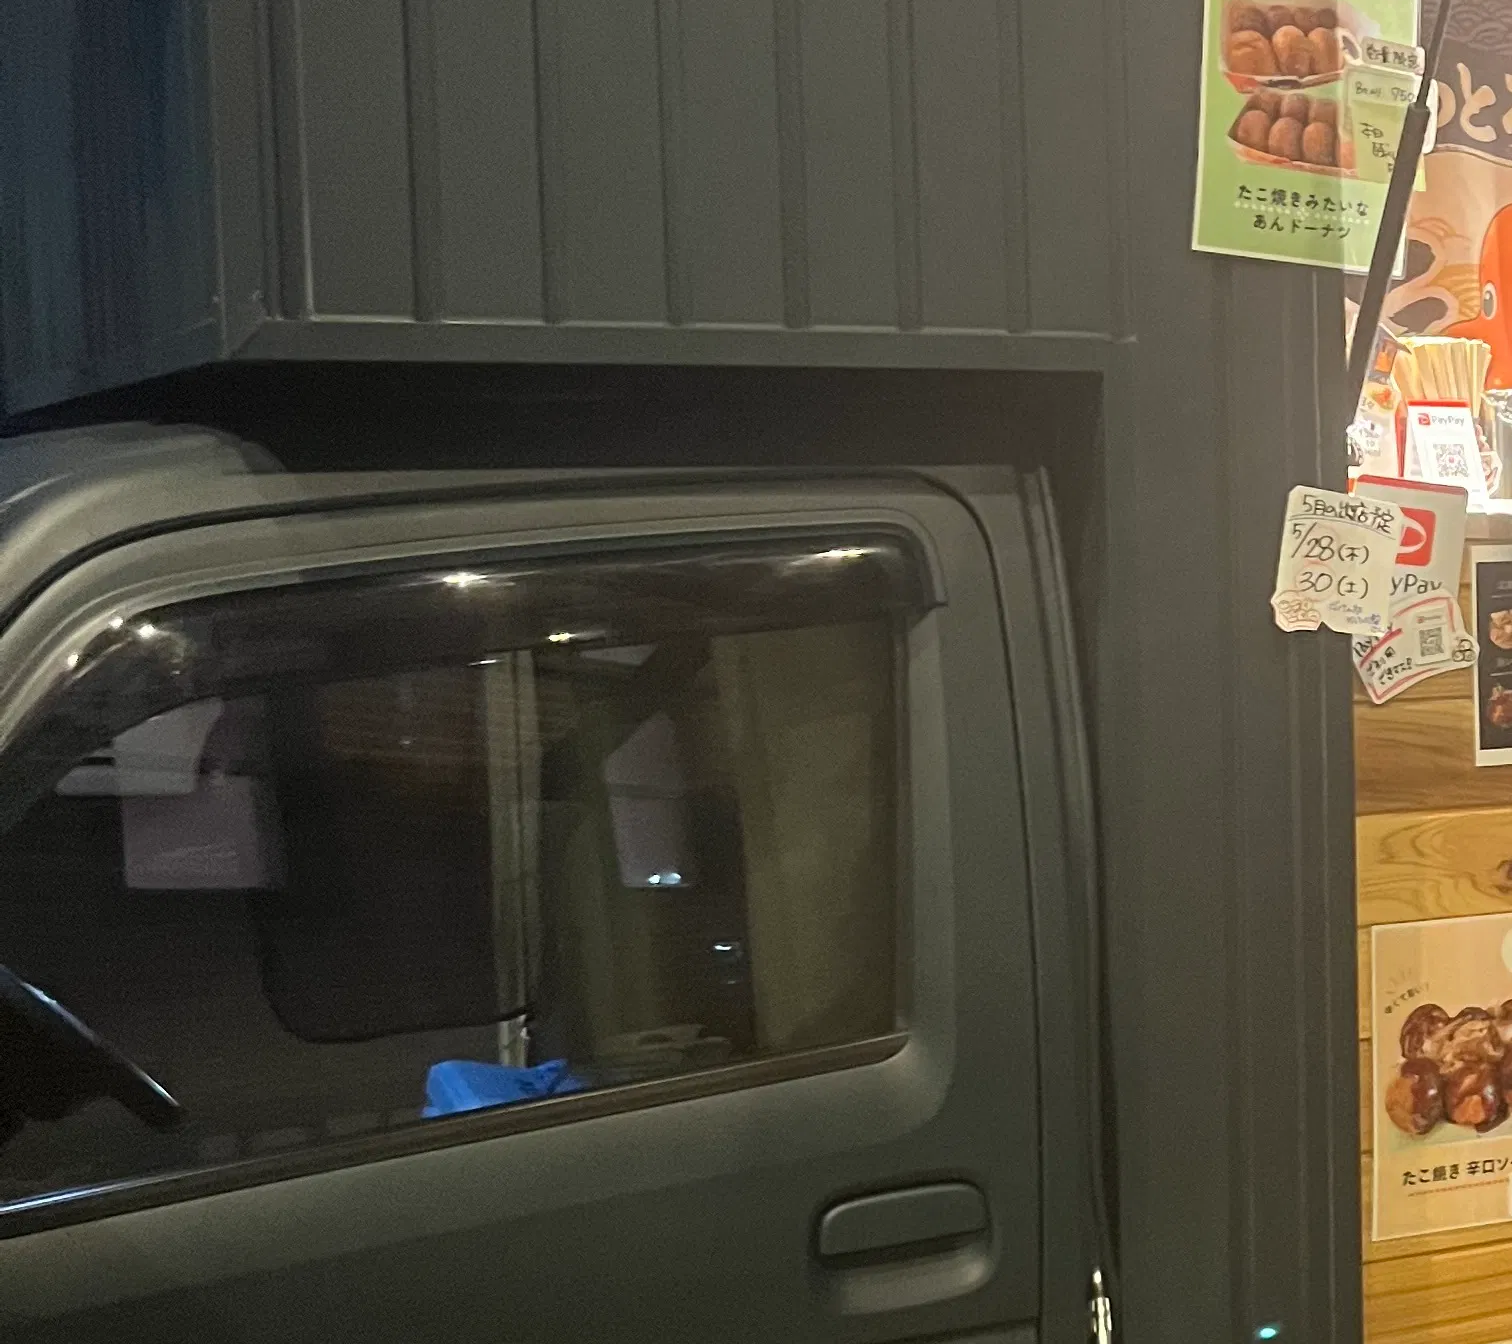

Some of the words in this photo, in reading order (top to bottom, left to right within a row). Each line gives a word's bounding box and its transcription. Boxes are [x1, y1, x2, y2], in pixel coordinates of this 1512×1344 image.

[1238, 185, 1368, 217] たこ焼きみたいな
[1253, 214, 1351, 239] あんドーナツ
[1431, 414, 1465, 427] PayPay
[1402, 1163, 1460, 1186] たこ焼き
